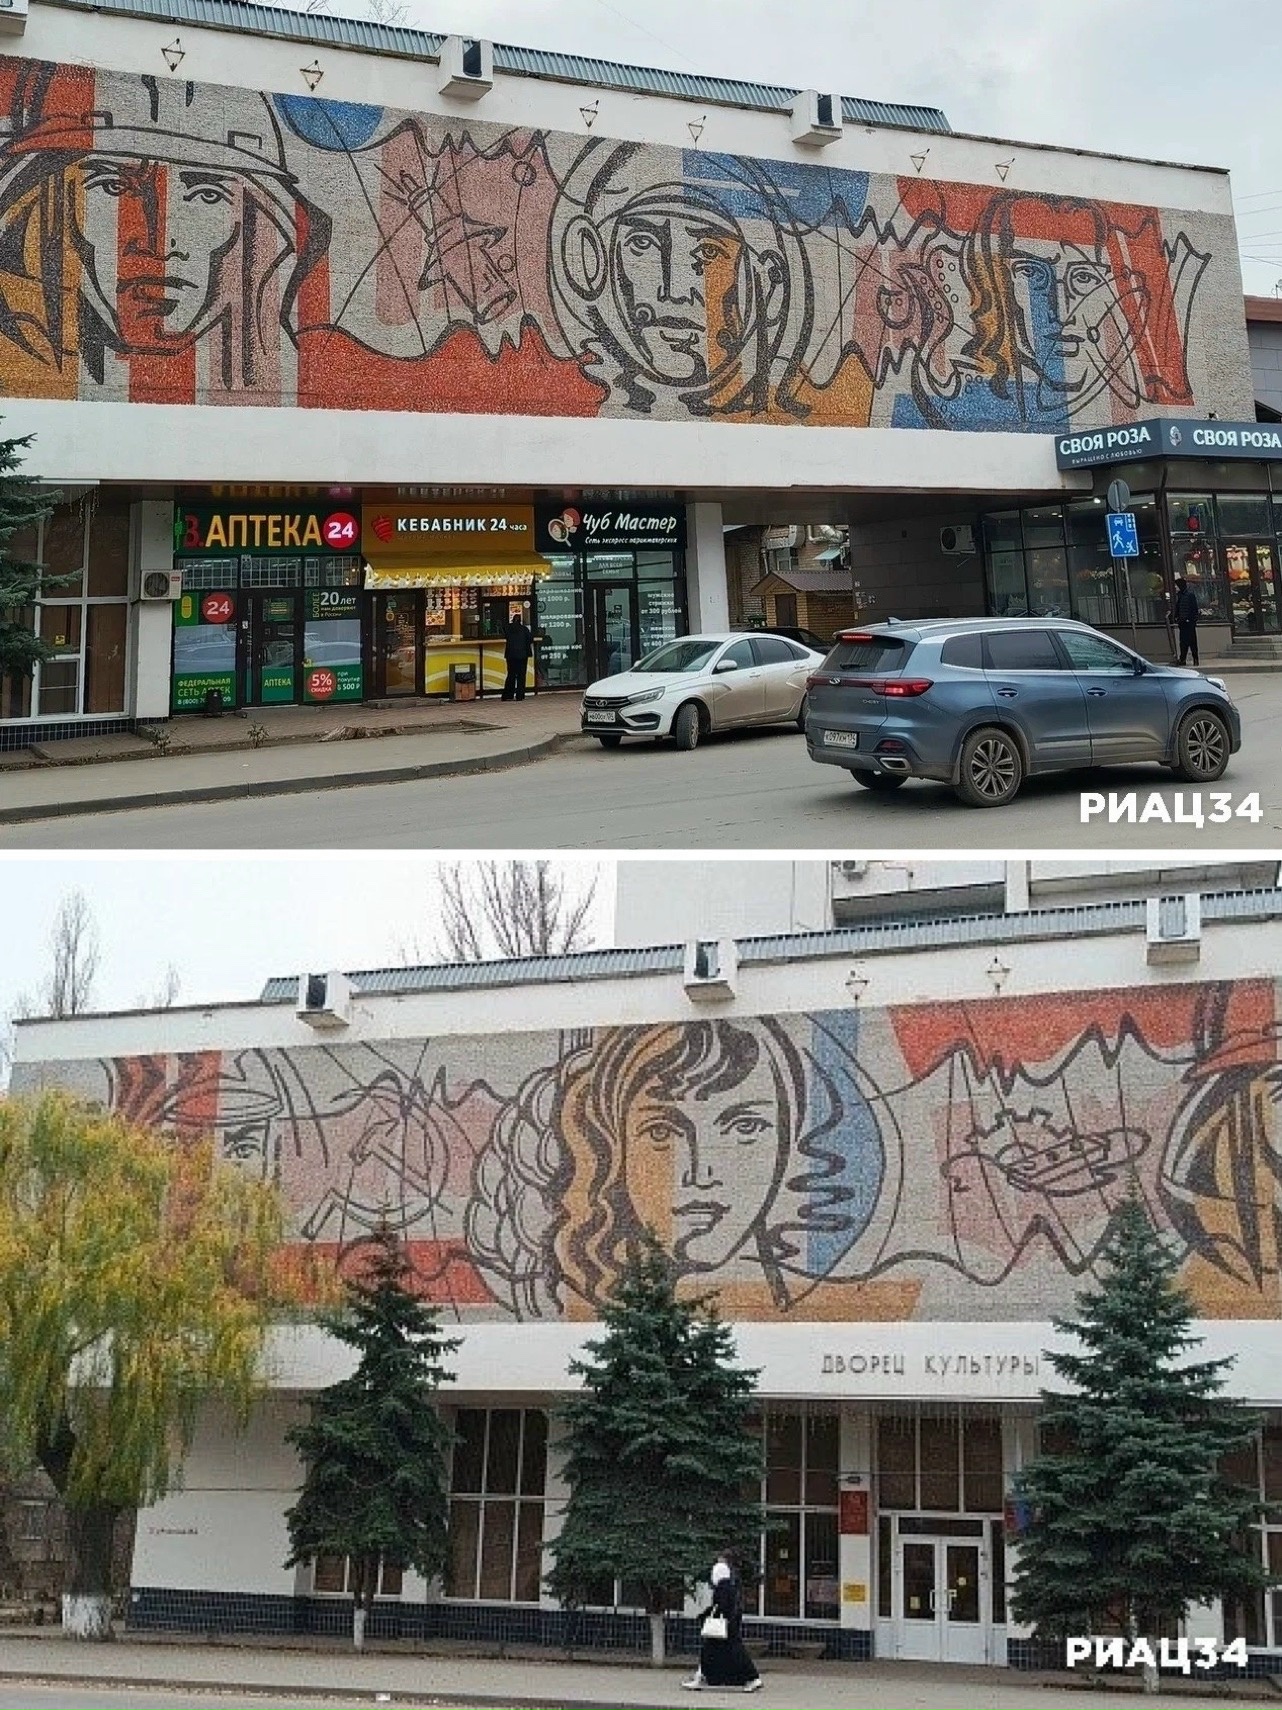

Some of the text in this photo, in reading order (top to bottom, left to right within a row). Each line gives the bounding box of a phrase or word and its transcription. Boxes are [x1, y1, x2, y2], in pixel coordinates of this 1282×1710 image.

[1060, 427, 1152, 455] СВОЯ РОЗА
[1193, 429, 1282, 448] СВОЯ РОЗА
[397, 518, 487, 532] КЕБАБНИК
[490, 518, 507, 532] 24
[583, 511, 677, 535] Чуб Мастер
[328, 522, 354, 539] 24
[585, 536, 678, 545] Сеть экспресс парикмахерских
[312, 592, 320, 618] БОЛЕЕ
[320, 591, 356, 606] 20 лет
[207, 601, 230, 615] 24
[661, 606, 682, 615] рублей
[178, 677, 231, 688] ФЕДЕРАЛЬНАЯ
[264, 678, 292, 687] АПТЕКА
[311, 673, 332, 687] 5%
[178, 687, 200, 697] СЕТЬ
[821, 1355, 1040, 1377] ДВОРЕЦ КУЛЬТУРЫ
